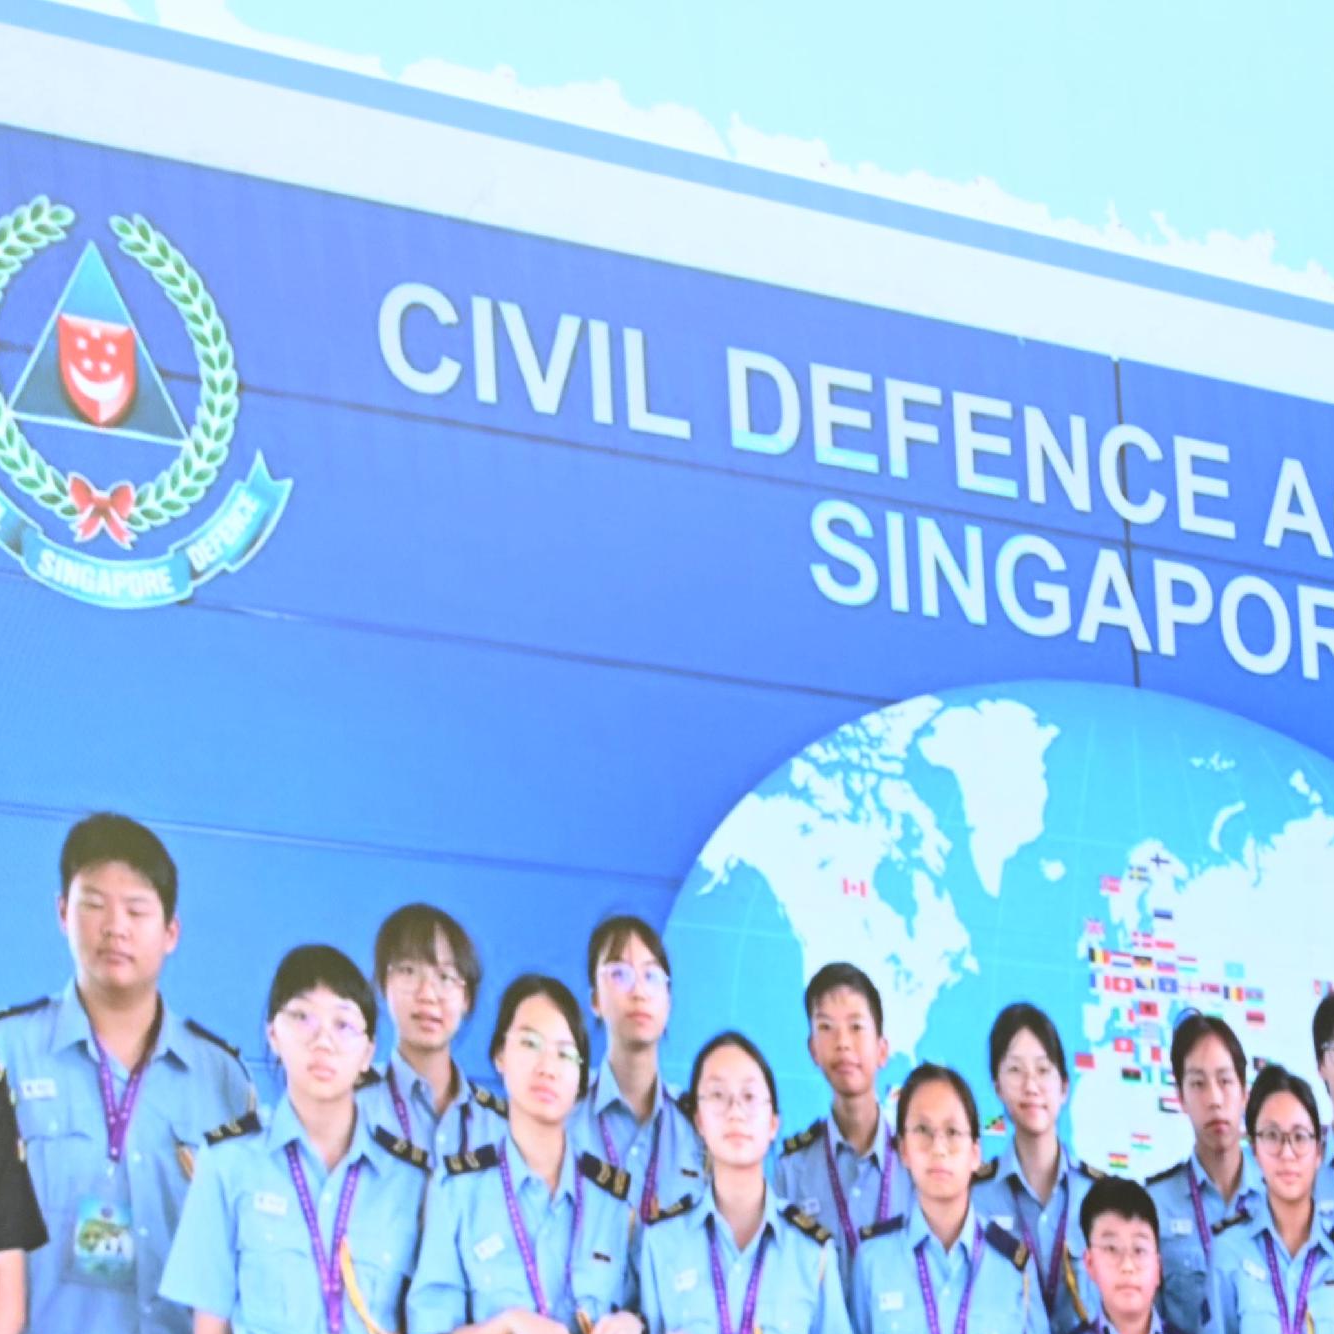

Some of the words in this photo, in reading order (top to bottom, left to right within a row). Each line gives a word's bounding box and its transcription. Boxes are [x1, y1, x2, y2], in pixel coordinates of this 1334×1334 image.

[378, 282, 691, 440] CIVIL
[727, 346, 1235, 539] DEFENCE
[36, 548, 176, 597] SINGAPORE
[185, 490, 260, 572] DEFENCE
